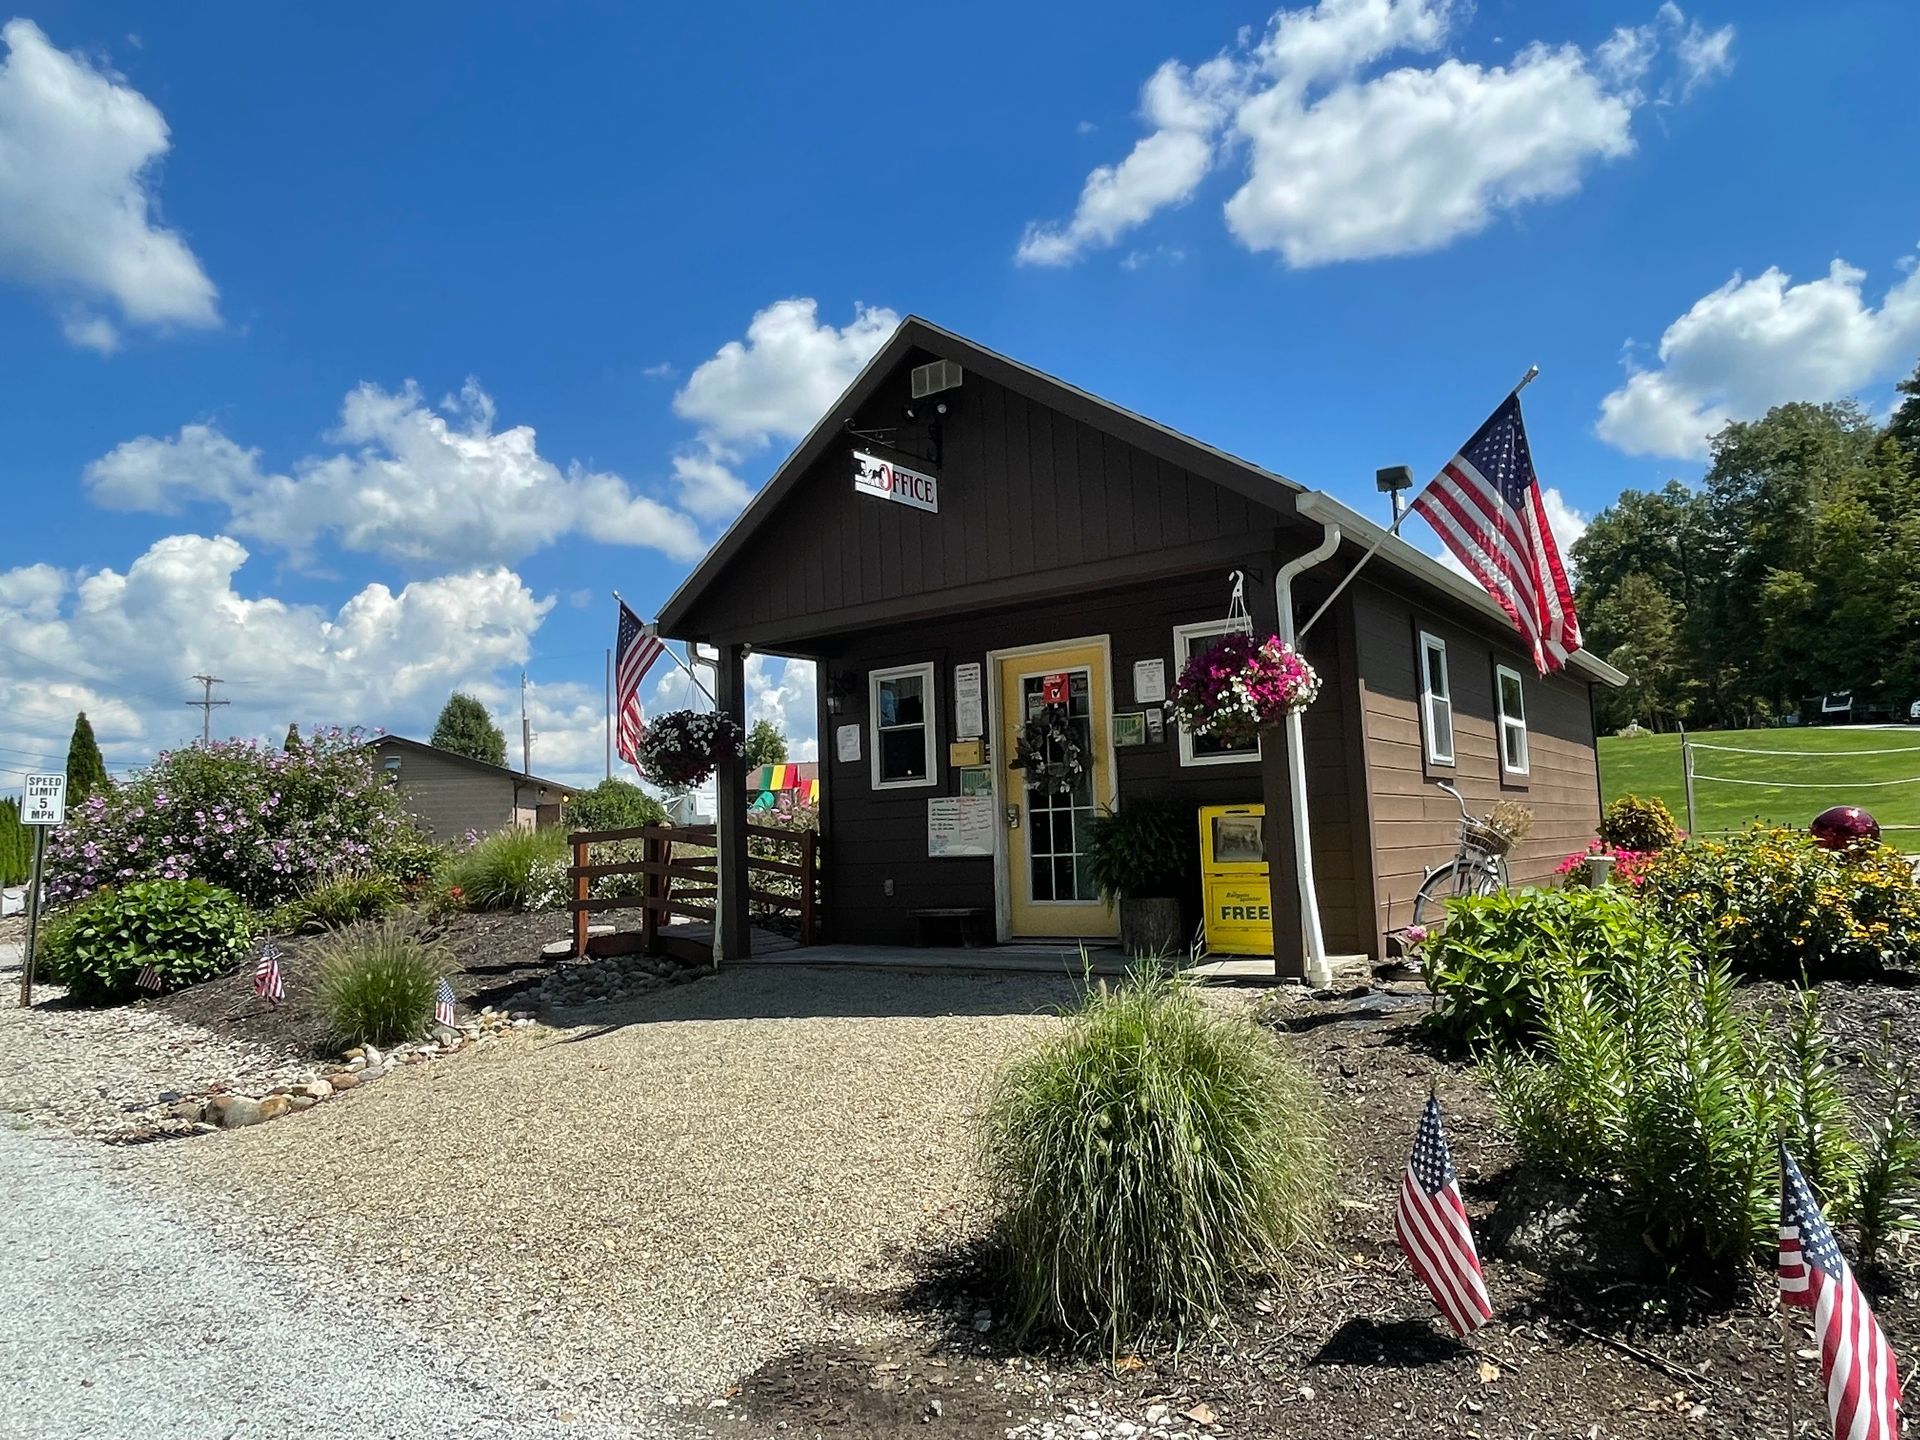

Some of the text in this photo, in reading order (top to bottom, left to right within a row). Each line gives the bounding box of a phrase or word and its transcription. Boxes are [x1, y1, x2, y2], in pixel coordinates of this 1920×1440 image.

[879, 463, 934, 504] OFFICE
[28, 777, 62, 787] SPEED
[29, 787, 59, 796] LIMIT
[39, 798, 48, 809] 5
[31, 811, 54, 820] MPH
[1221, 906, 1270, 920] FREE
